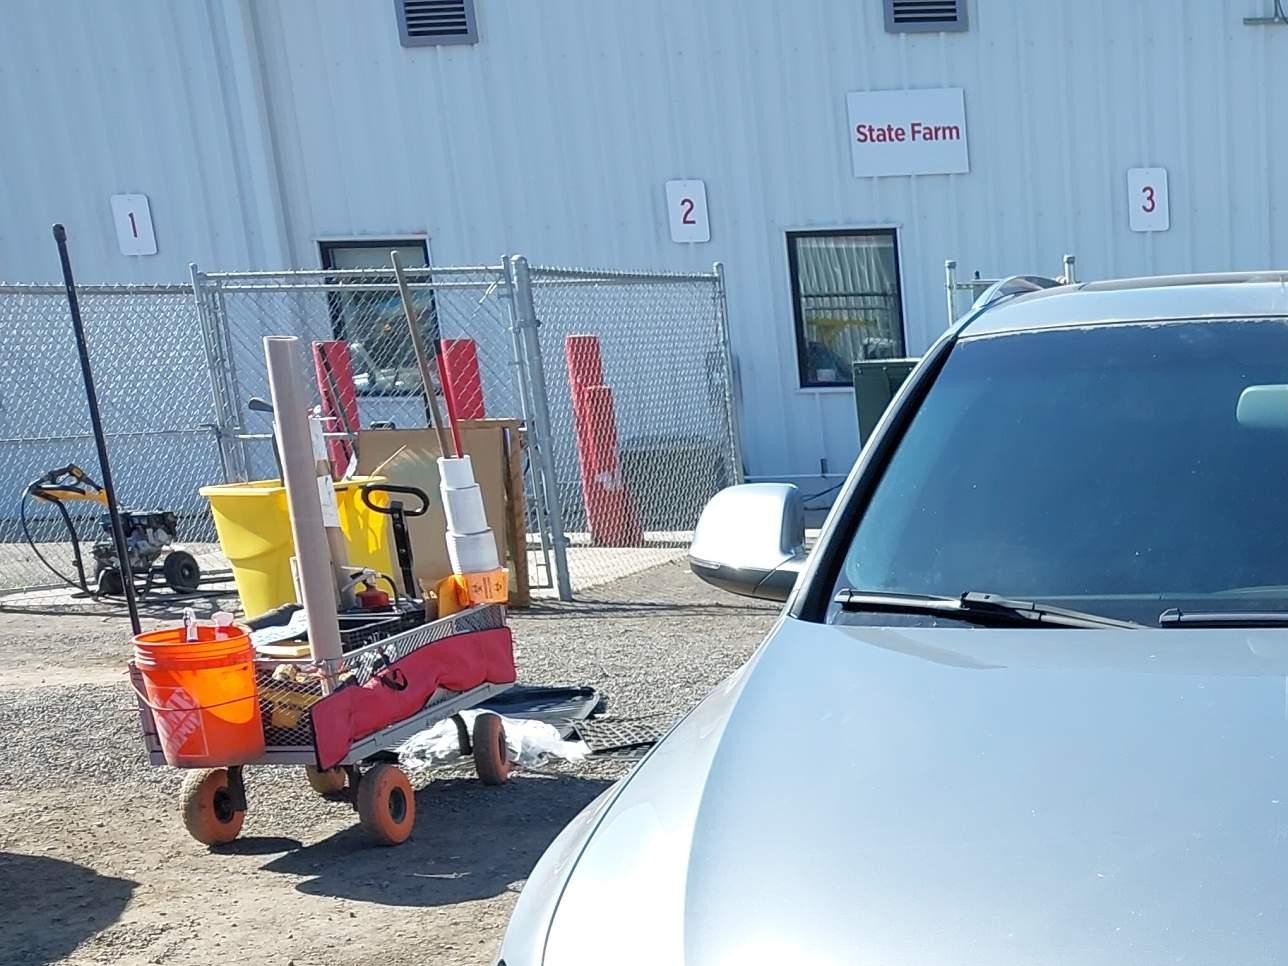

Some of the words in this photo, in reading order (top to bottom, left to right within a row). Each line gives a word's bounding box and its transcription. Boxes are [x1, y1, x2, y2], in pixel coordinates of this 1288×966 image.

[856, 124, 905, 143] State
[911, 122, 960, 141] Farm
[680, 198, 697, 225] 2
[1141, 186, 1156, 214] 3
[128, 212, 138, 238] 1
